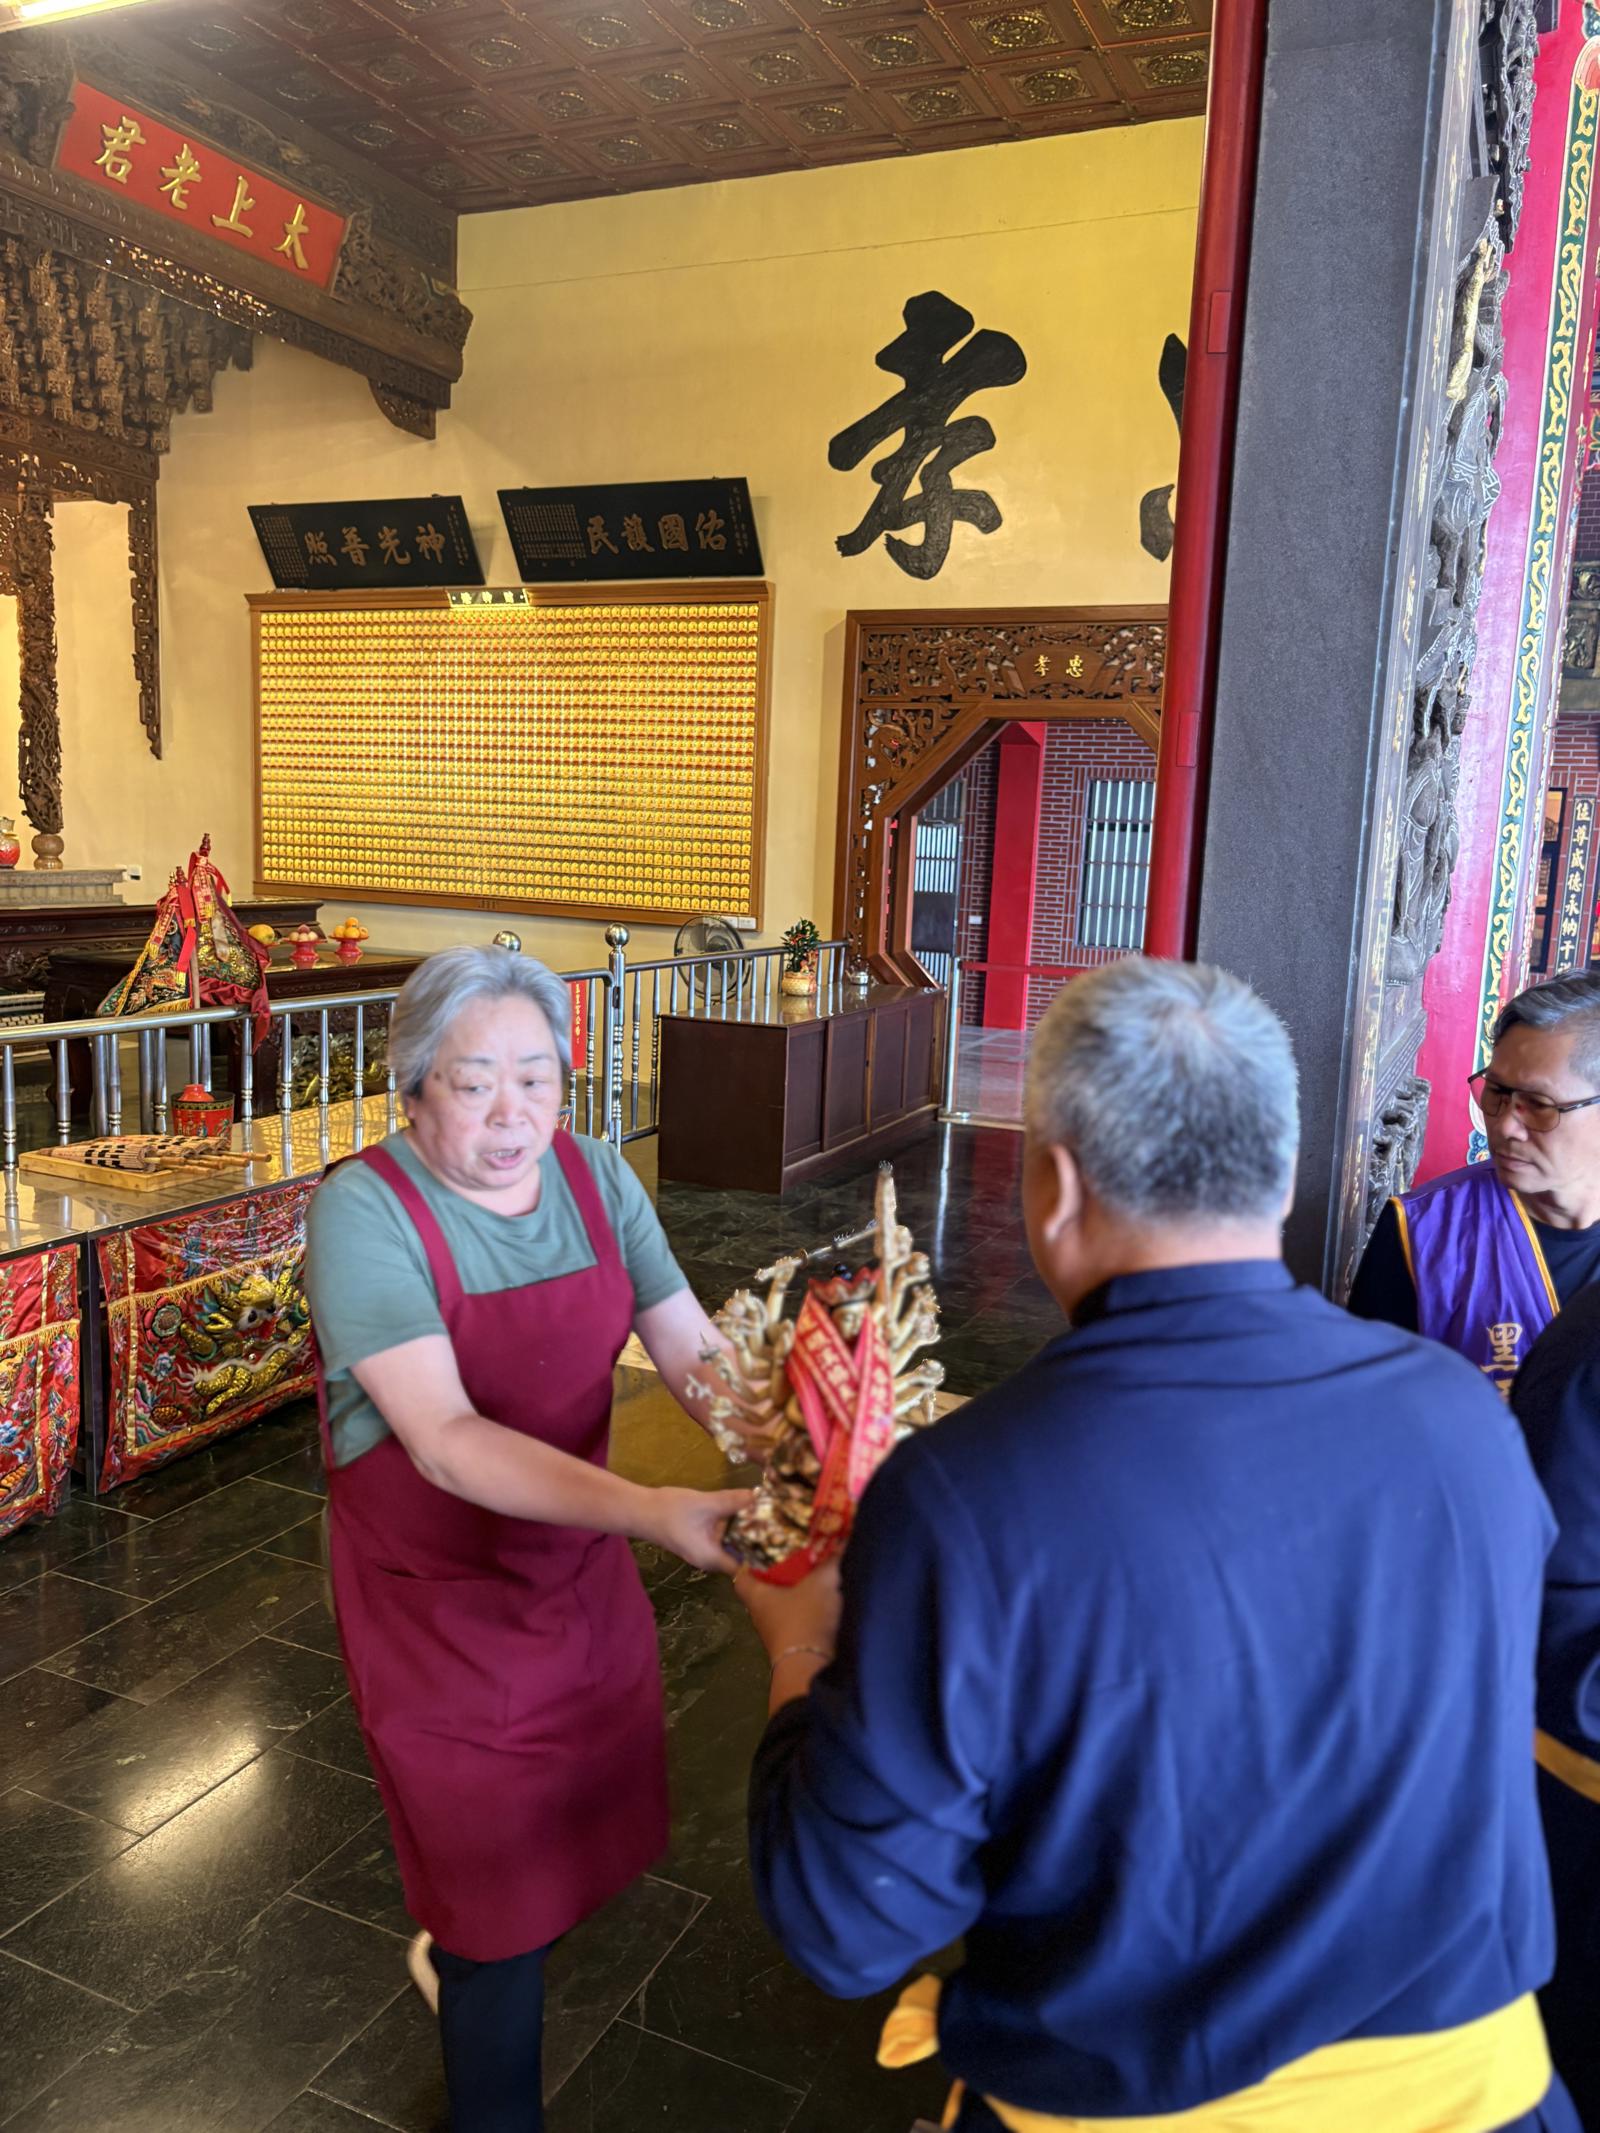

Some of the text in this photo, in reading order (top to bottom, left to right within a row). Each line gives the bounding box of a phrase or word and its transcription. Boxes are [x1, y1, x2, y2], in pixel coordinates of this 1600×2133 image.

[94, 115, 310, 270] 太上老君
[304, 522, 446, 567] 神光普照
[586, 509, 728, 556] 佑國護民
